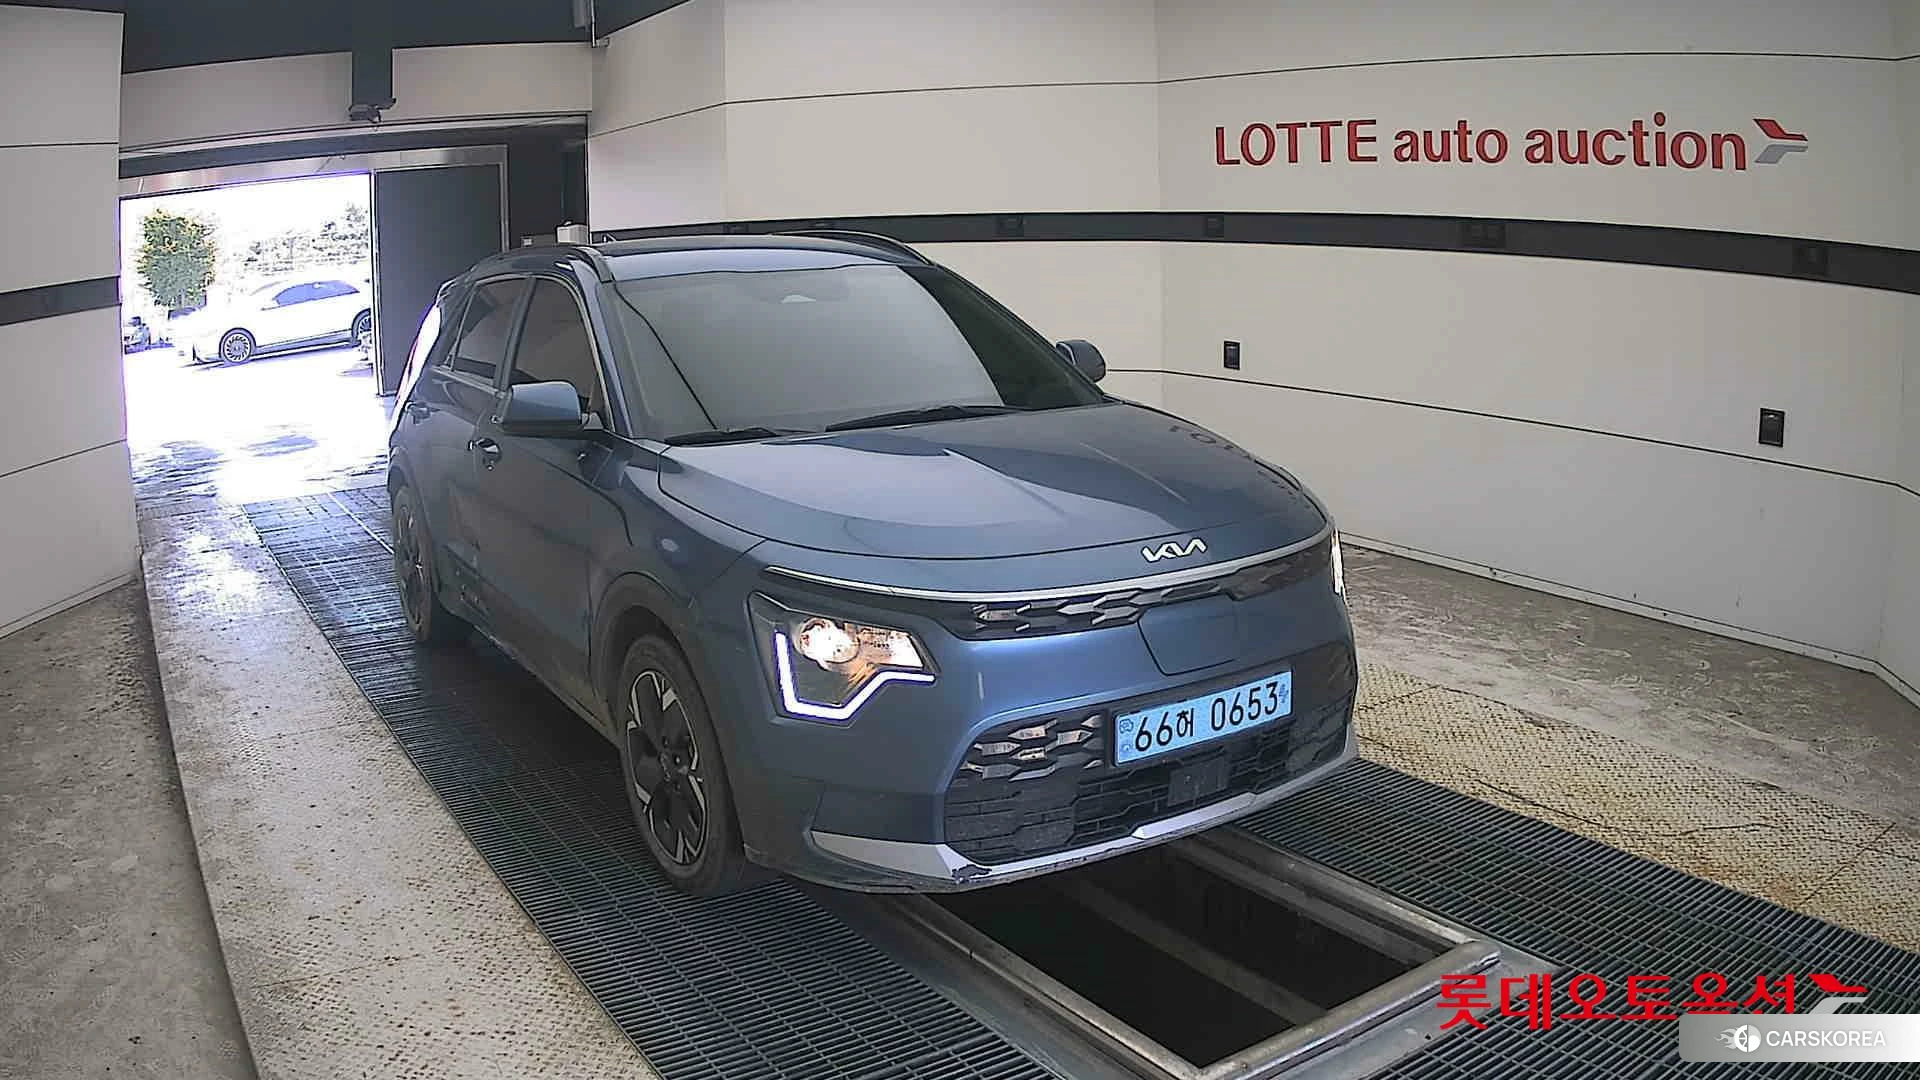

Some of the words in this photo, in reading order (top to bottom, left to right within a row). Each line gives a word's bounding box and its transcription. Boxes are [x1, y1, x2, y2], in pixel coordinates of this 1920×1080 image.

[1215, 119, 1378, 166] LOTTE
[1393, 119, 1508, 164] auto
[1524, 111, 1747, 170] auction
[1141, 537, 1207, 563] KIA
[1134, 707, 1194, 752] 66허
[1210, 681, 1279, 731] 0653
